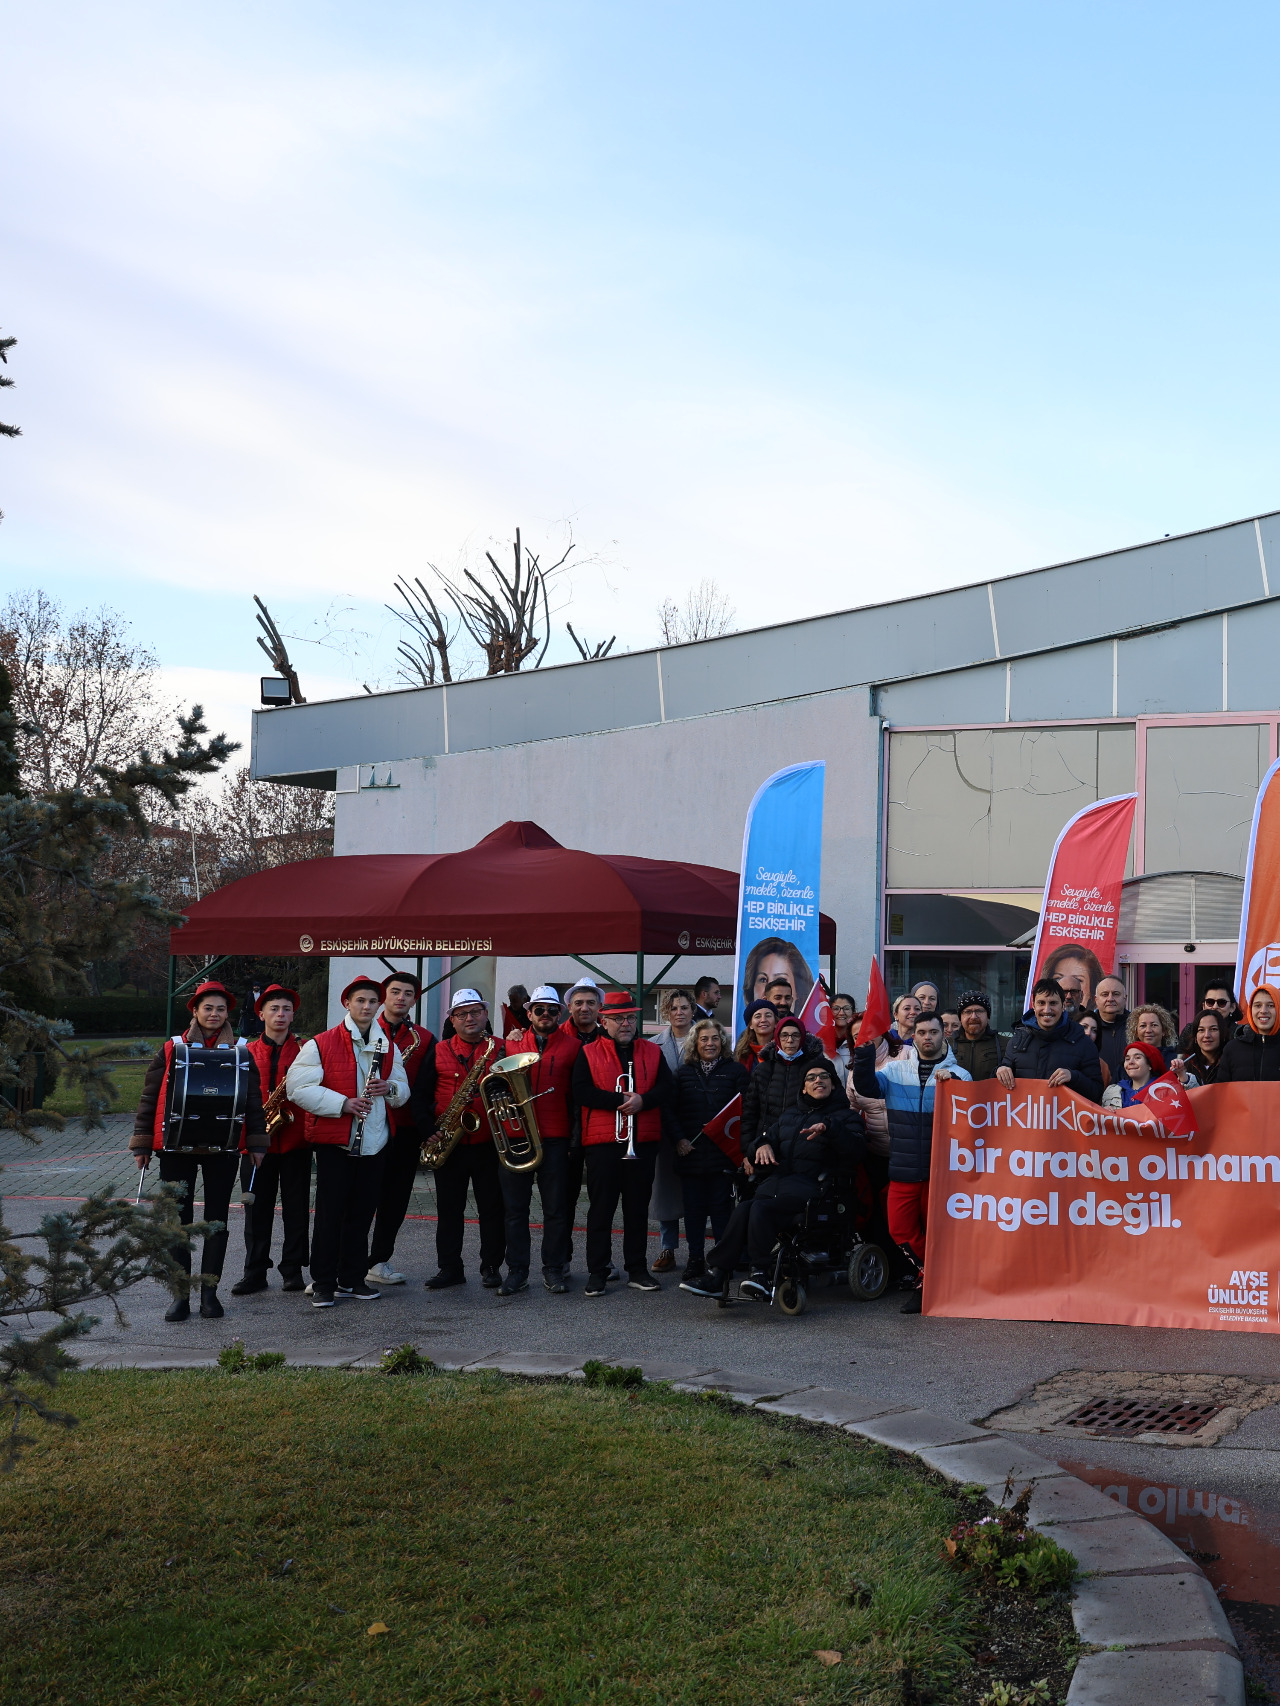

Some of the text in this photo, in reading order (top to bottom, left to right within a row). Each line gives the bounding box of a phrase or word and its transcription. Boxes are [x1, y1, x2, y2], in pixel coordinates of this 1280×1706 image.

[781, 885, 815, 899] özenle
[767, 900, 815, 916] BİRLİKLE
[1083, 900, 1116, 913] özenle
[749, 915, 806, 932] ESKİŞEHİR
[1045, 911, 1114, 928] HEP BİRLİKLE
[1049, 925, 1105, 940] ESKİŞEHİR
[321, 937, 369, 953] ESKİŞEHİR
[371, 936, 433, 952] BÜYÜKŞEHİR
[435, 937, 492, 951] BELEDİYESİ
[695, 935, 733, 951] ESKİŞEHİR
[949, 1138, 1002, 1174] bir
[1008, 1148, 1129, 1182] arada
[946, 1191, 1182, 1236] engel değil.
[1229, 1270, 1268, 1289] AYŞE
[1208, 1284, 1268, 1306] ÜNLÜCE
